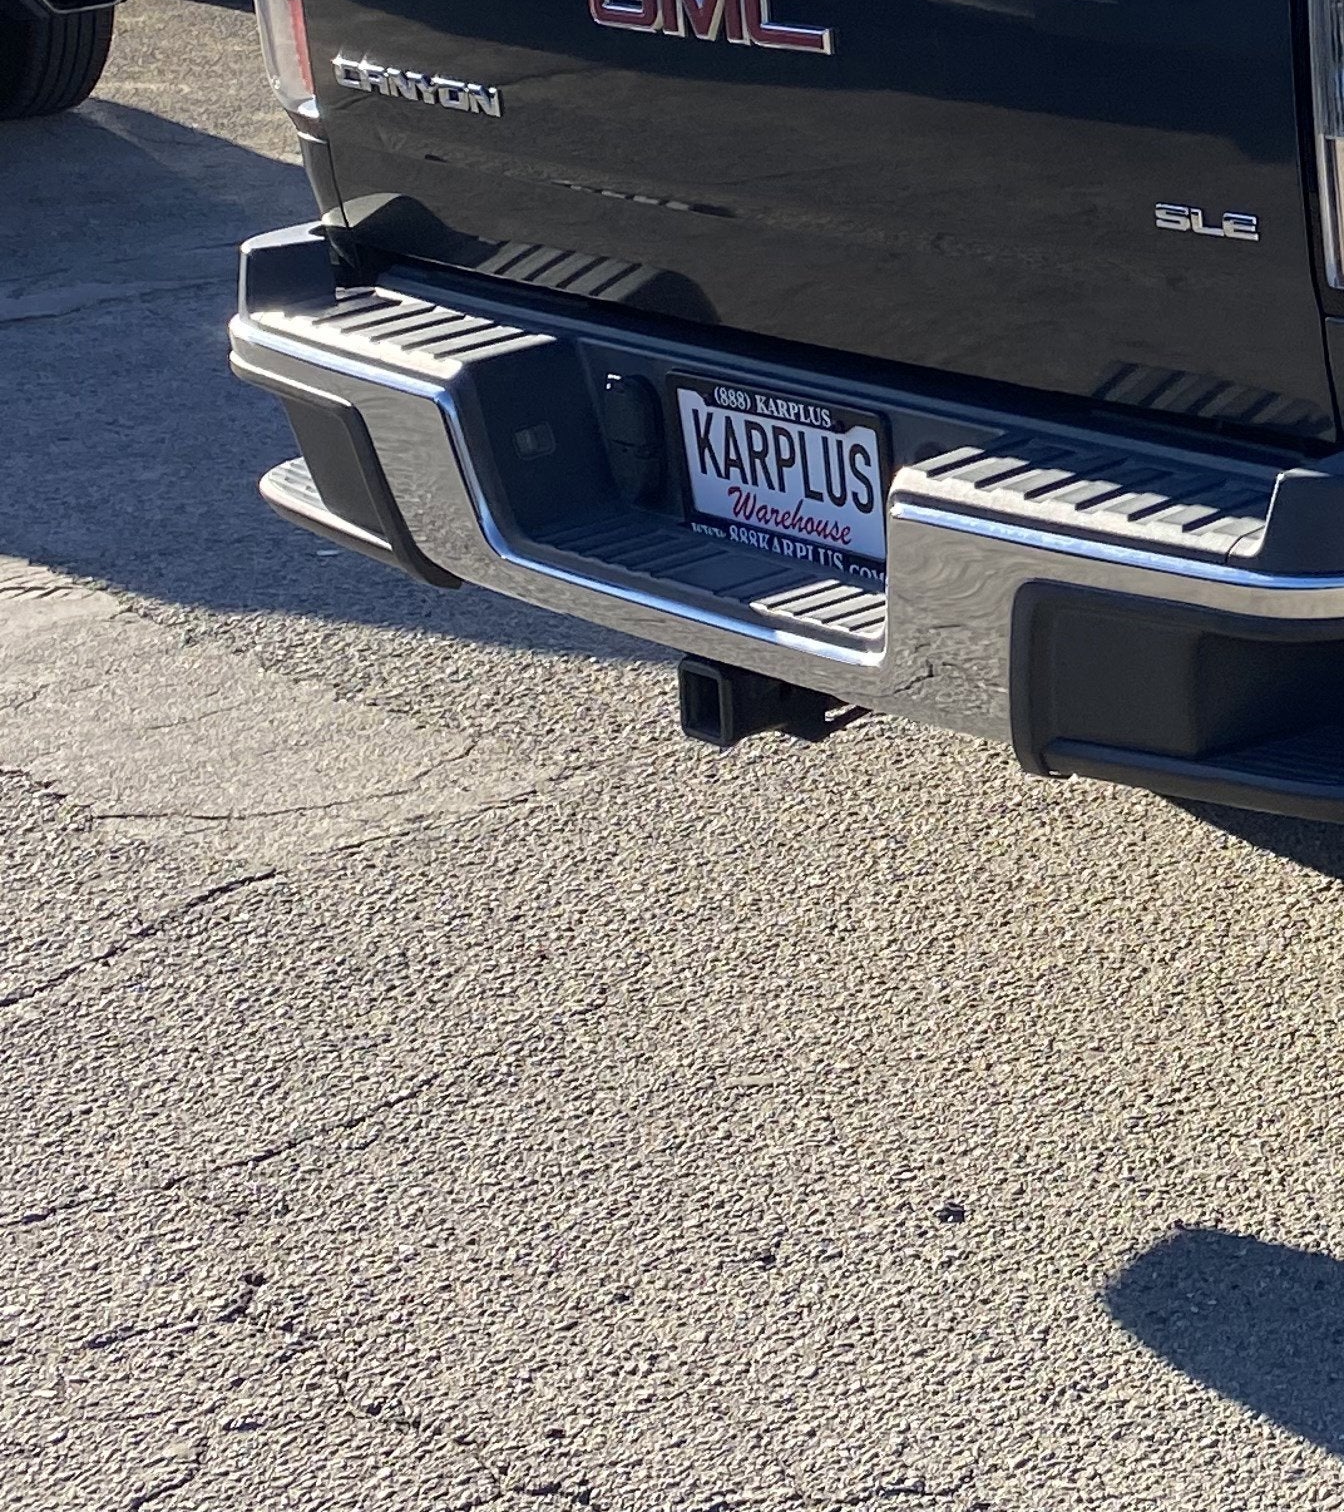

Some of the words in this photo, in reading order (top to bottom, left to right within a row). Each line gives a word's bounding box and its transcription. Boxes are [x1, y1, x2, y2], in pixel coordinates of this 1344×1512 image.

[331, 55, 504, 118] CANYON
[1154, 202, 1260, 242] SLE
[713, 386, 751, 412] (888)
[754, 394, 832, 429] KARPLUS
[691, 408, 875, 514] KARPLUS
[727, 486, 852, 546] Warehouse
